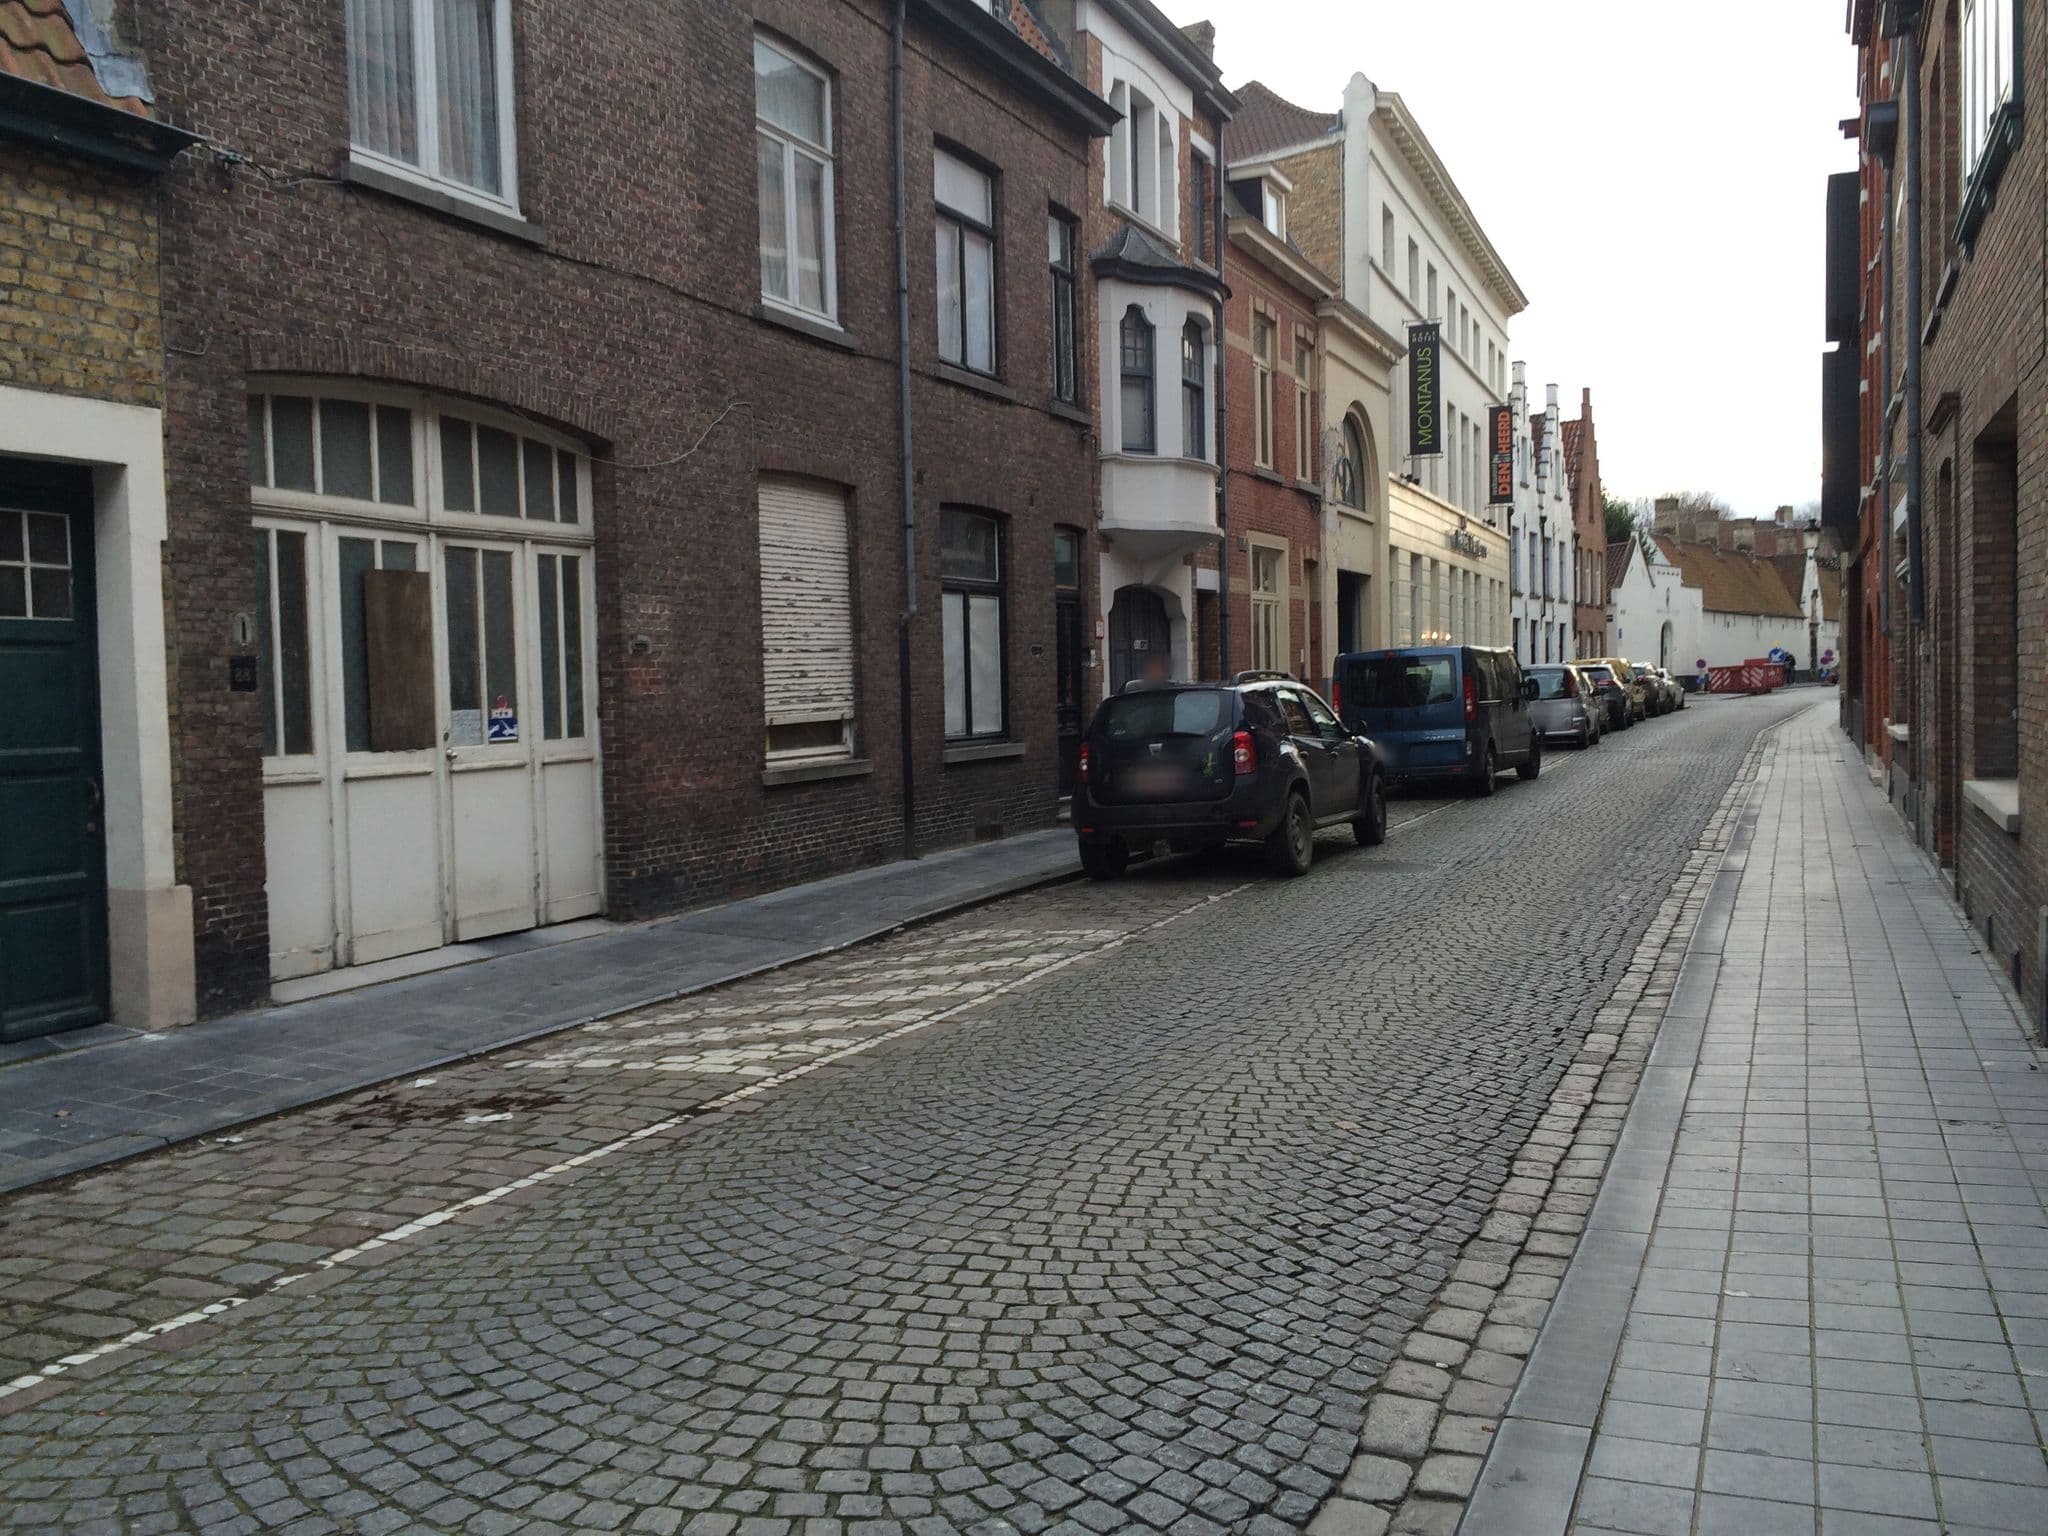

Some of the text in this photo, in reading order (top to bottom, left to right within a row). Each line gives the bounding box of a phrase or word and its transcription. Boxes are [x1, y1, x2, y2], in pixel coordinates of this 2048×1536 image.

[1416, 347, 1432, 446] MONTANUS
[1497, 411, 1511, 496] DEN HEERD
